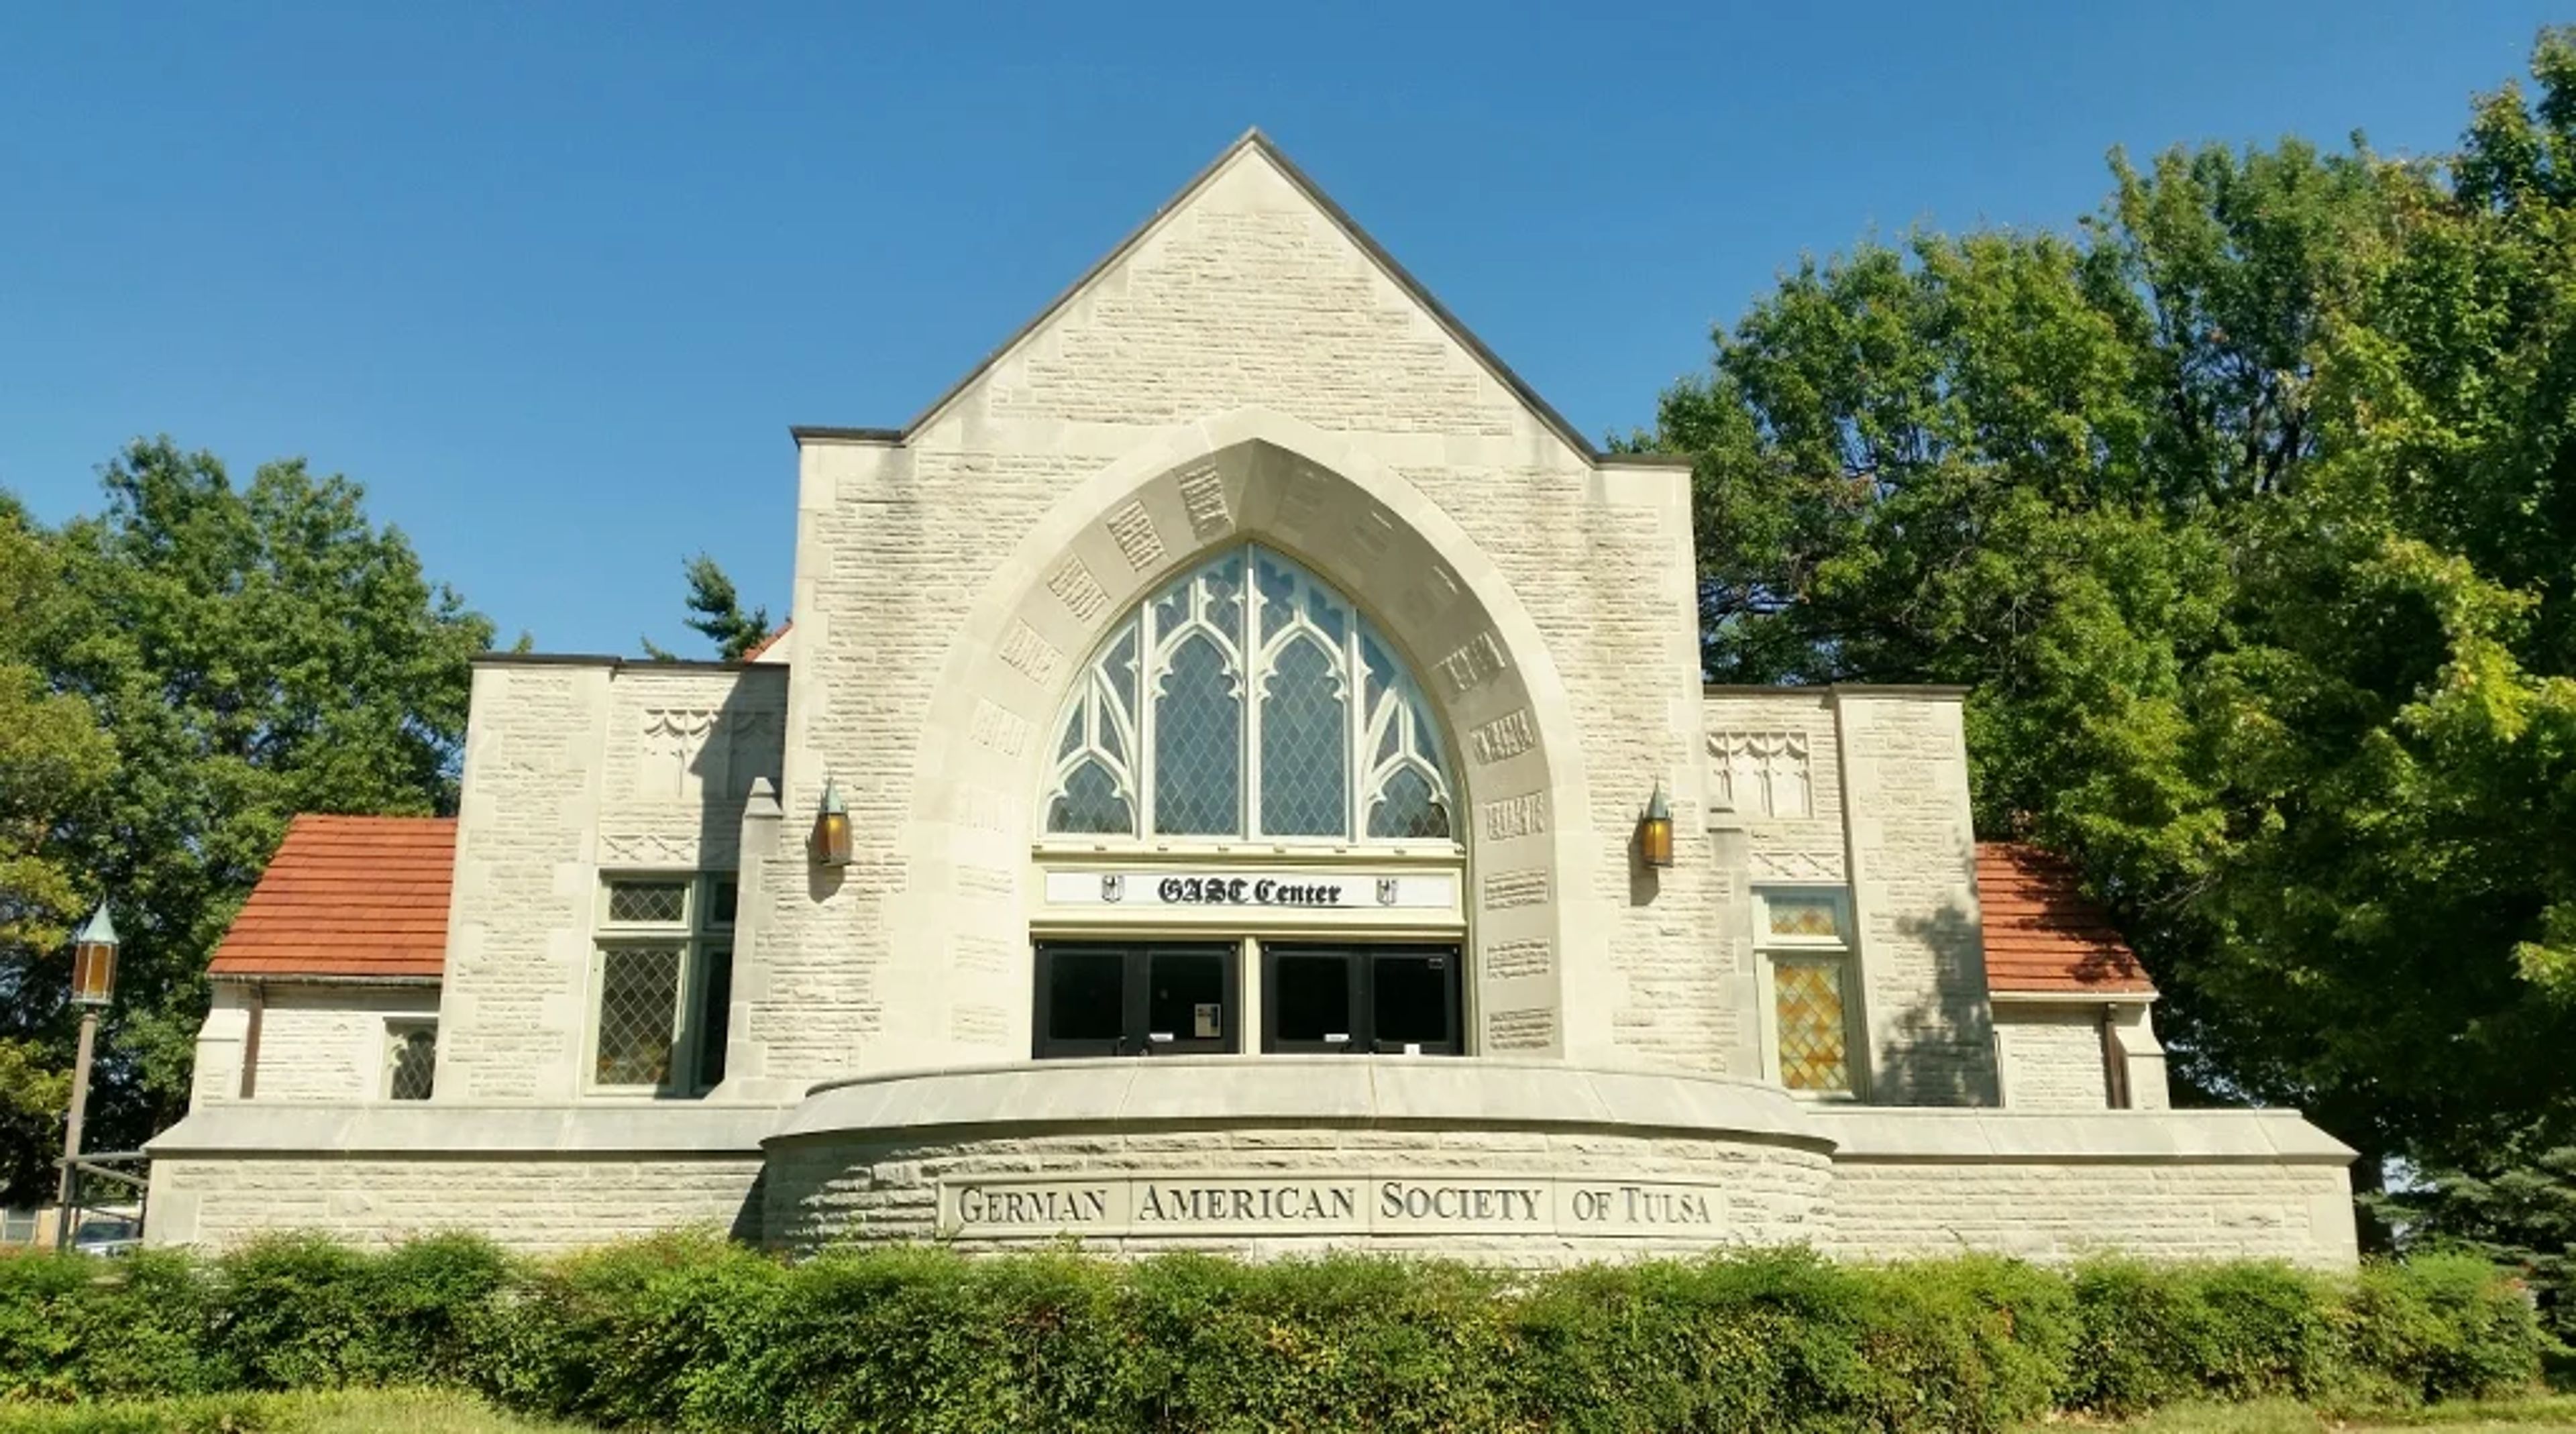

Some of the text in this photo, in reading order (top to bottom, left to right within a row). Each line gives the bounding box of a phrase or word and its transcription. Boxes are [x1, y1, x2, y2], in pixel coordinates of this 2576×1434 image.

[1158, 877, 1341, 904] GAST Center
[959, 1182, 1711, 1224] GERMAN AMERICAN SOCIETY OF TULSA
